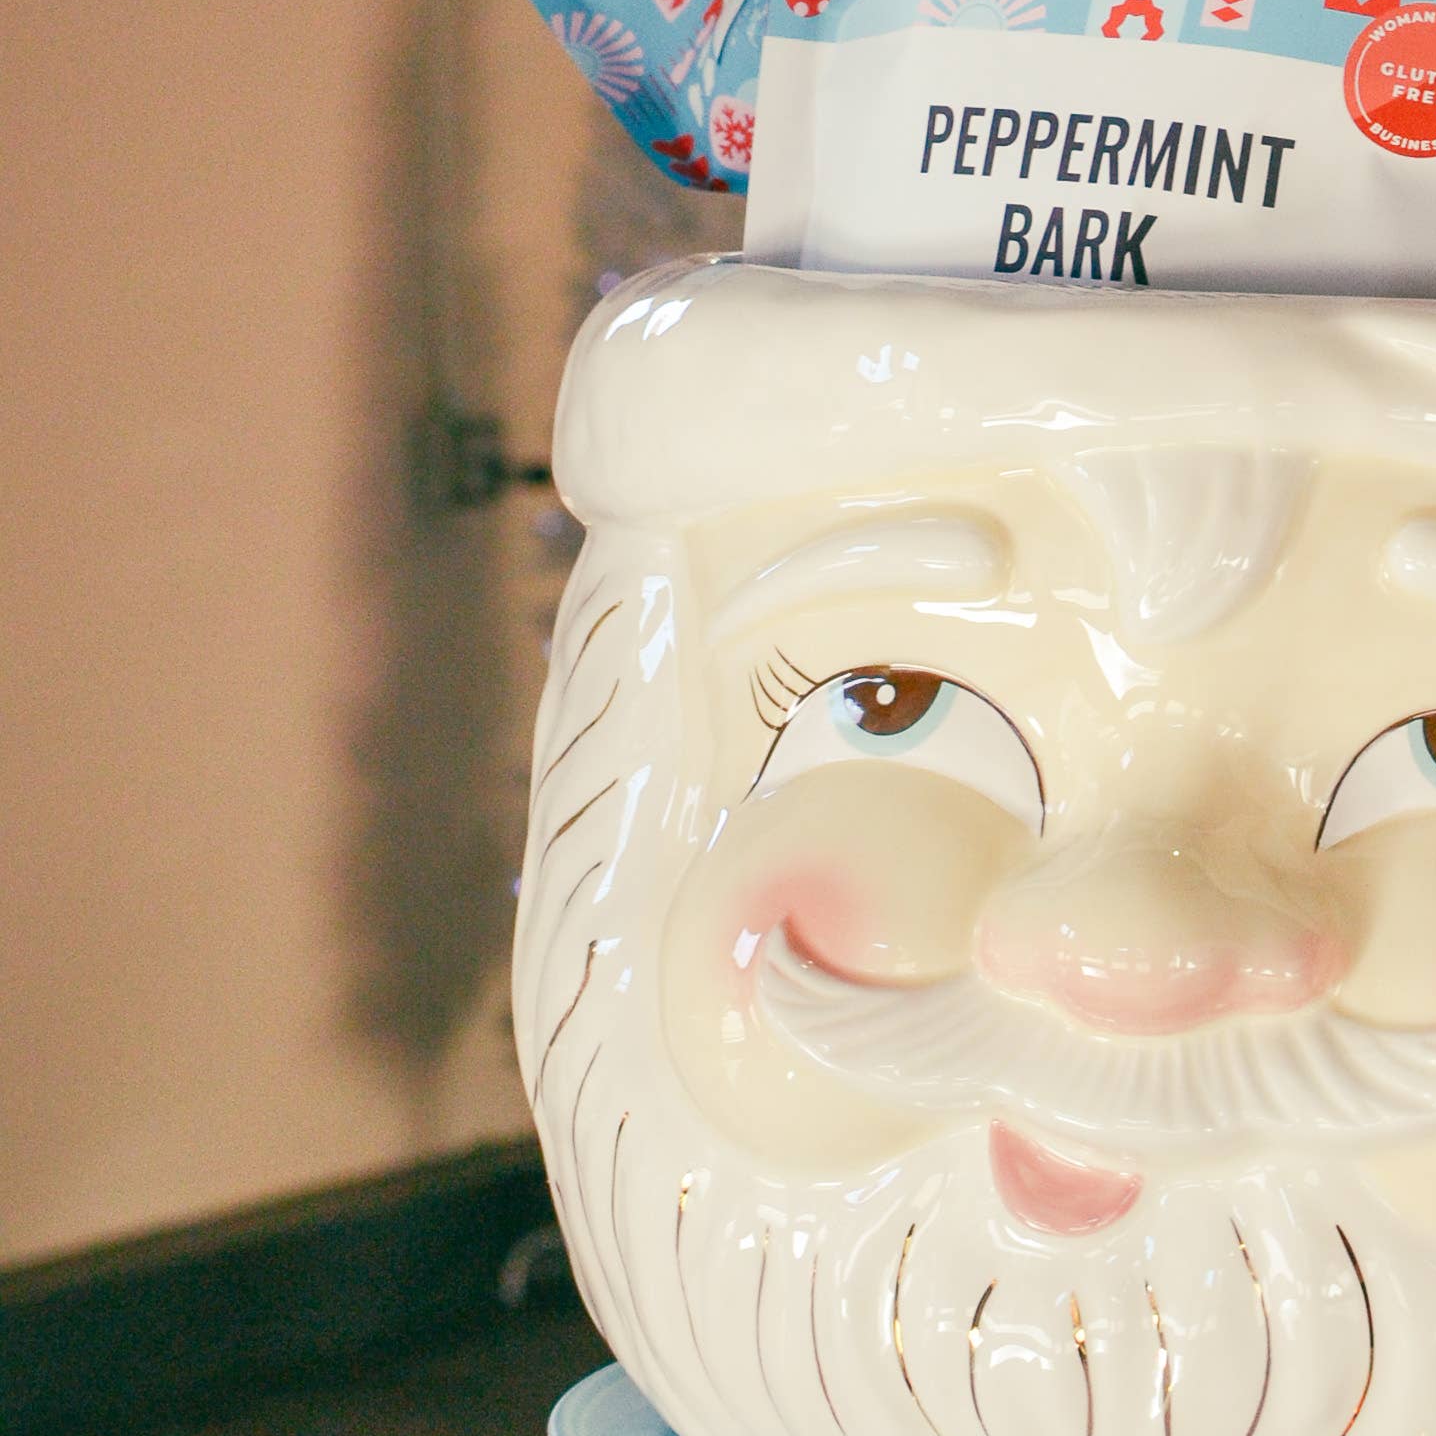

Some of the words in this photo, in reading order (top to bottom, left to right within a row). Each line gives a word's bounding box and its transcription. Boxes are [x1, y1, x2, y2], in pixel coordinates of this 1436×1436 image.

[1368, 11, 1436, 43] WOMAN
[920, 105, 1297, 209] PEPPERMINT
[994, 202, 1159, 286] BARK
